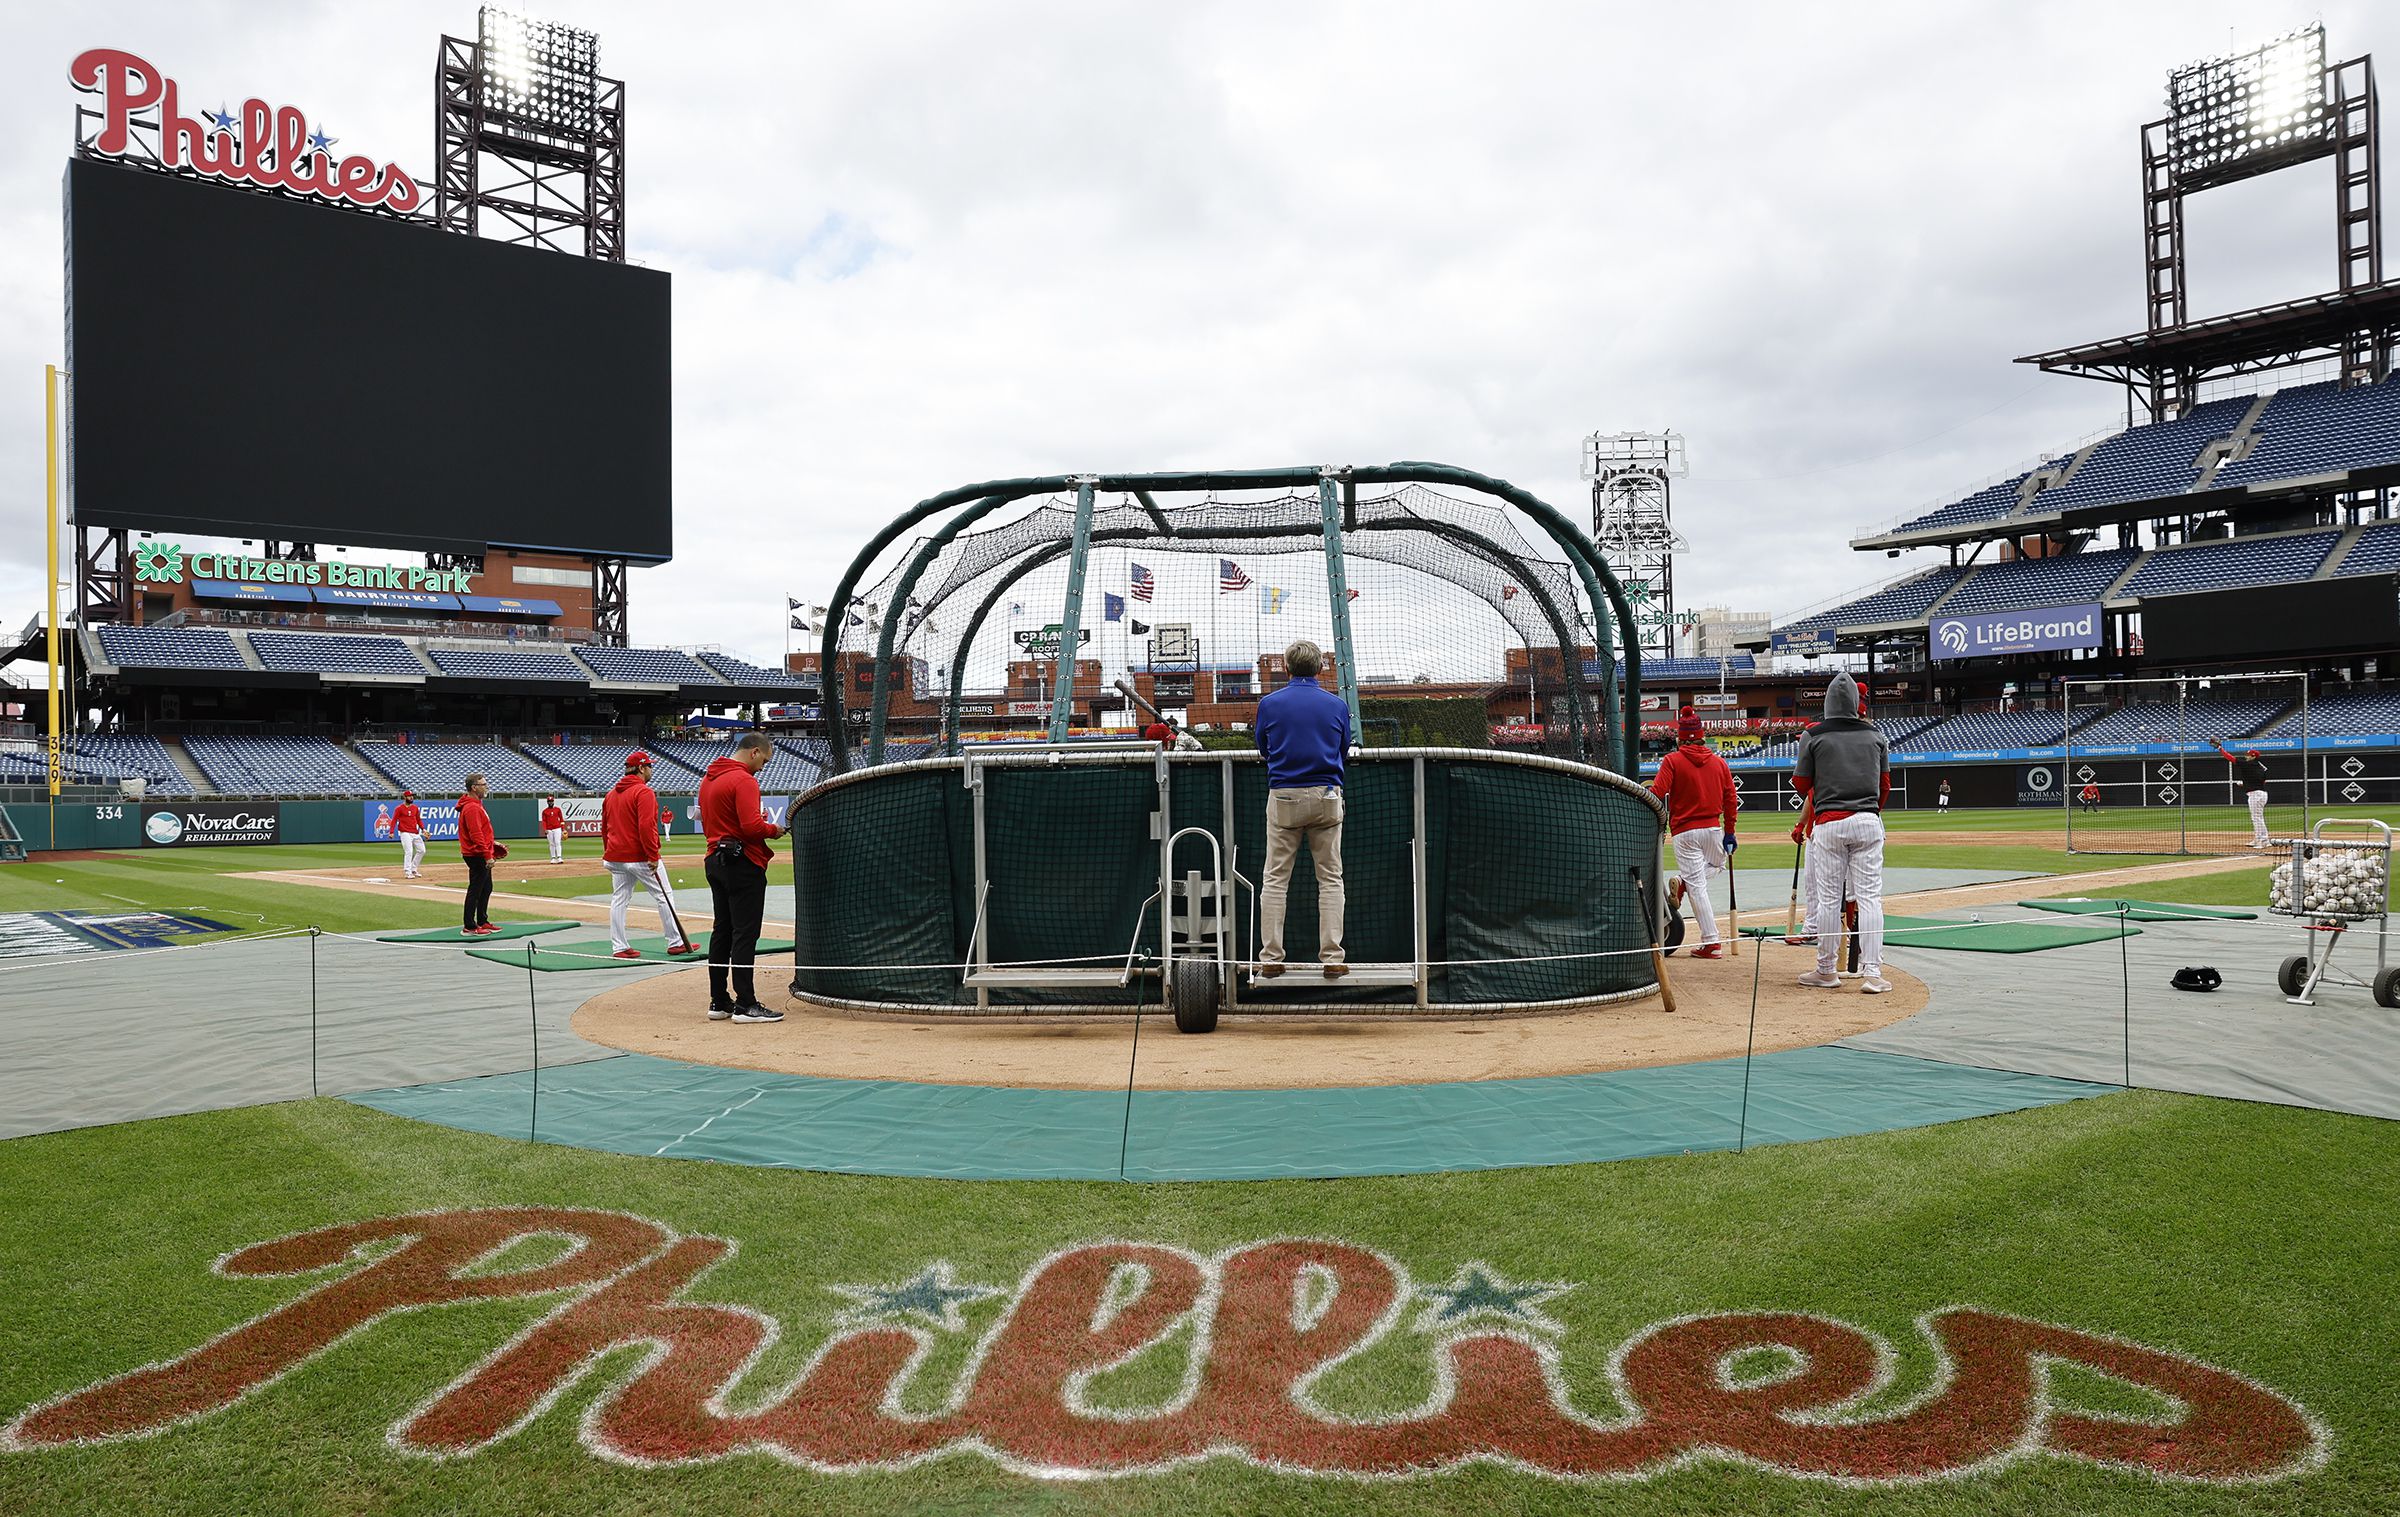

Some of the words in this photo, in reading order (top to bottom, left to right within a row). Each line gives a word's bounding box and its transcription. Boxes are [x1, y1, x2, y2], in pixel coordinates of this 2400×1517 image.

[67, 45, 421, 214] Phillies
[190, 552, 321, 585] Citizens
[327, 560, 404, 590] Bank
[407, 565, 472, 594] Park
[332, 590, 391, 600] HARRY
[1579, 611, 1649, 627] Cizns
[1653, 608, 1697, 626] Bank
[1976, 614, 2093, 645] LifeBrand
[1639, 722, 1670, 731] dweiser
[1721, 739, 1752, 749] PLAY
[2234, 740, 2285, 749] Independence
[2333, 737, 2367, 746] ibx.com
[2028, 748, 2054, 757] ibx.com
[2085, 745, 2129, 755] Independence
[2170, 743, 2200, 752] ibxcom
[1952, 751, 1992, 760] Independence
[2034, 774, 2045, 784] R
[2018, 791, 2062, 799] ROTHMAN
[95, 806, 123, 820] 334
[418, 806, 461, 820] ERWI
[561, 801, 602, 820] Yueng
[184, 812, 274, 832] NovaCare
[572, 821, 602, 833] LAGE
[184, 832, 272, 843] REHABILITATION
[0, 1204, 2333, 1488] Phillies
